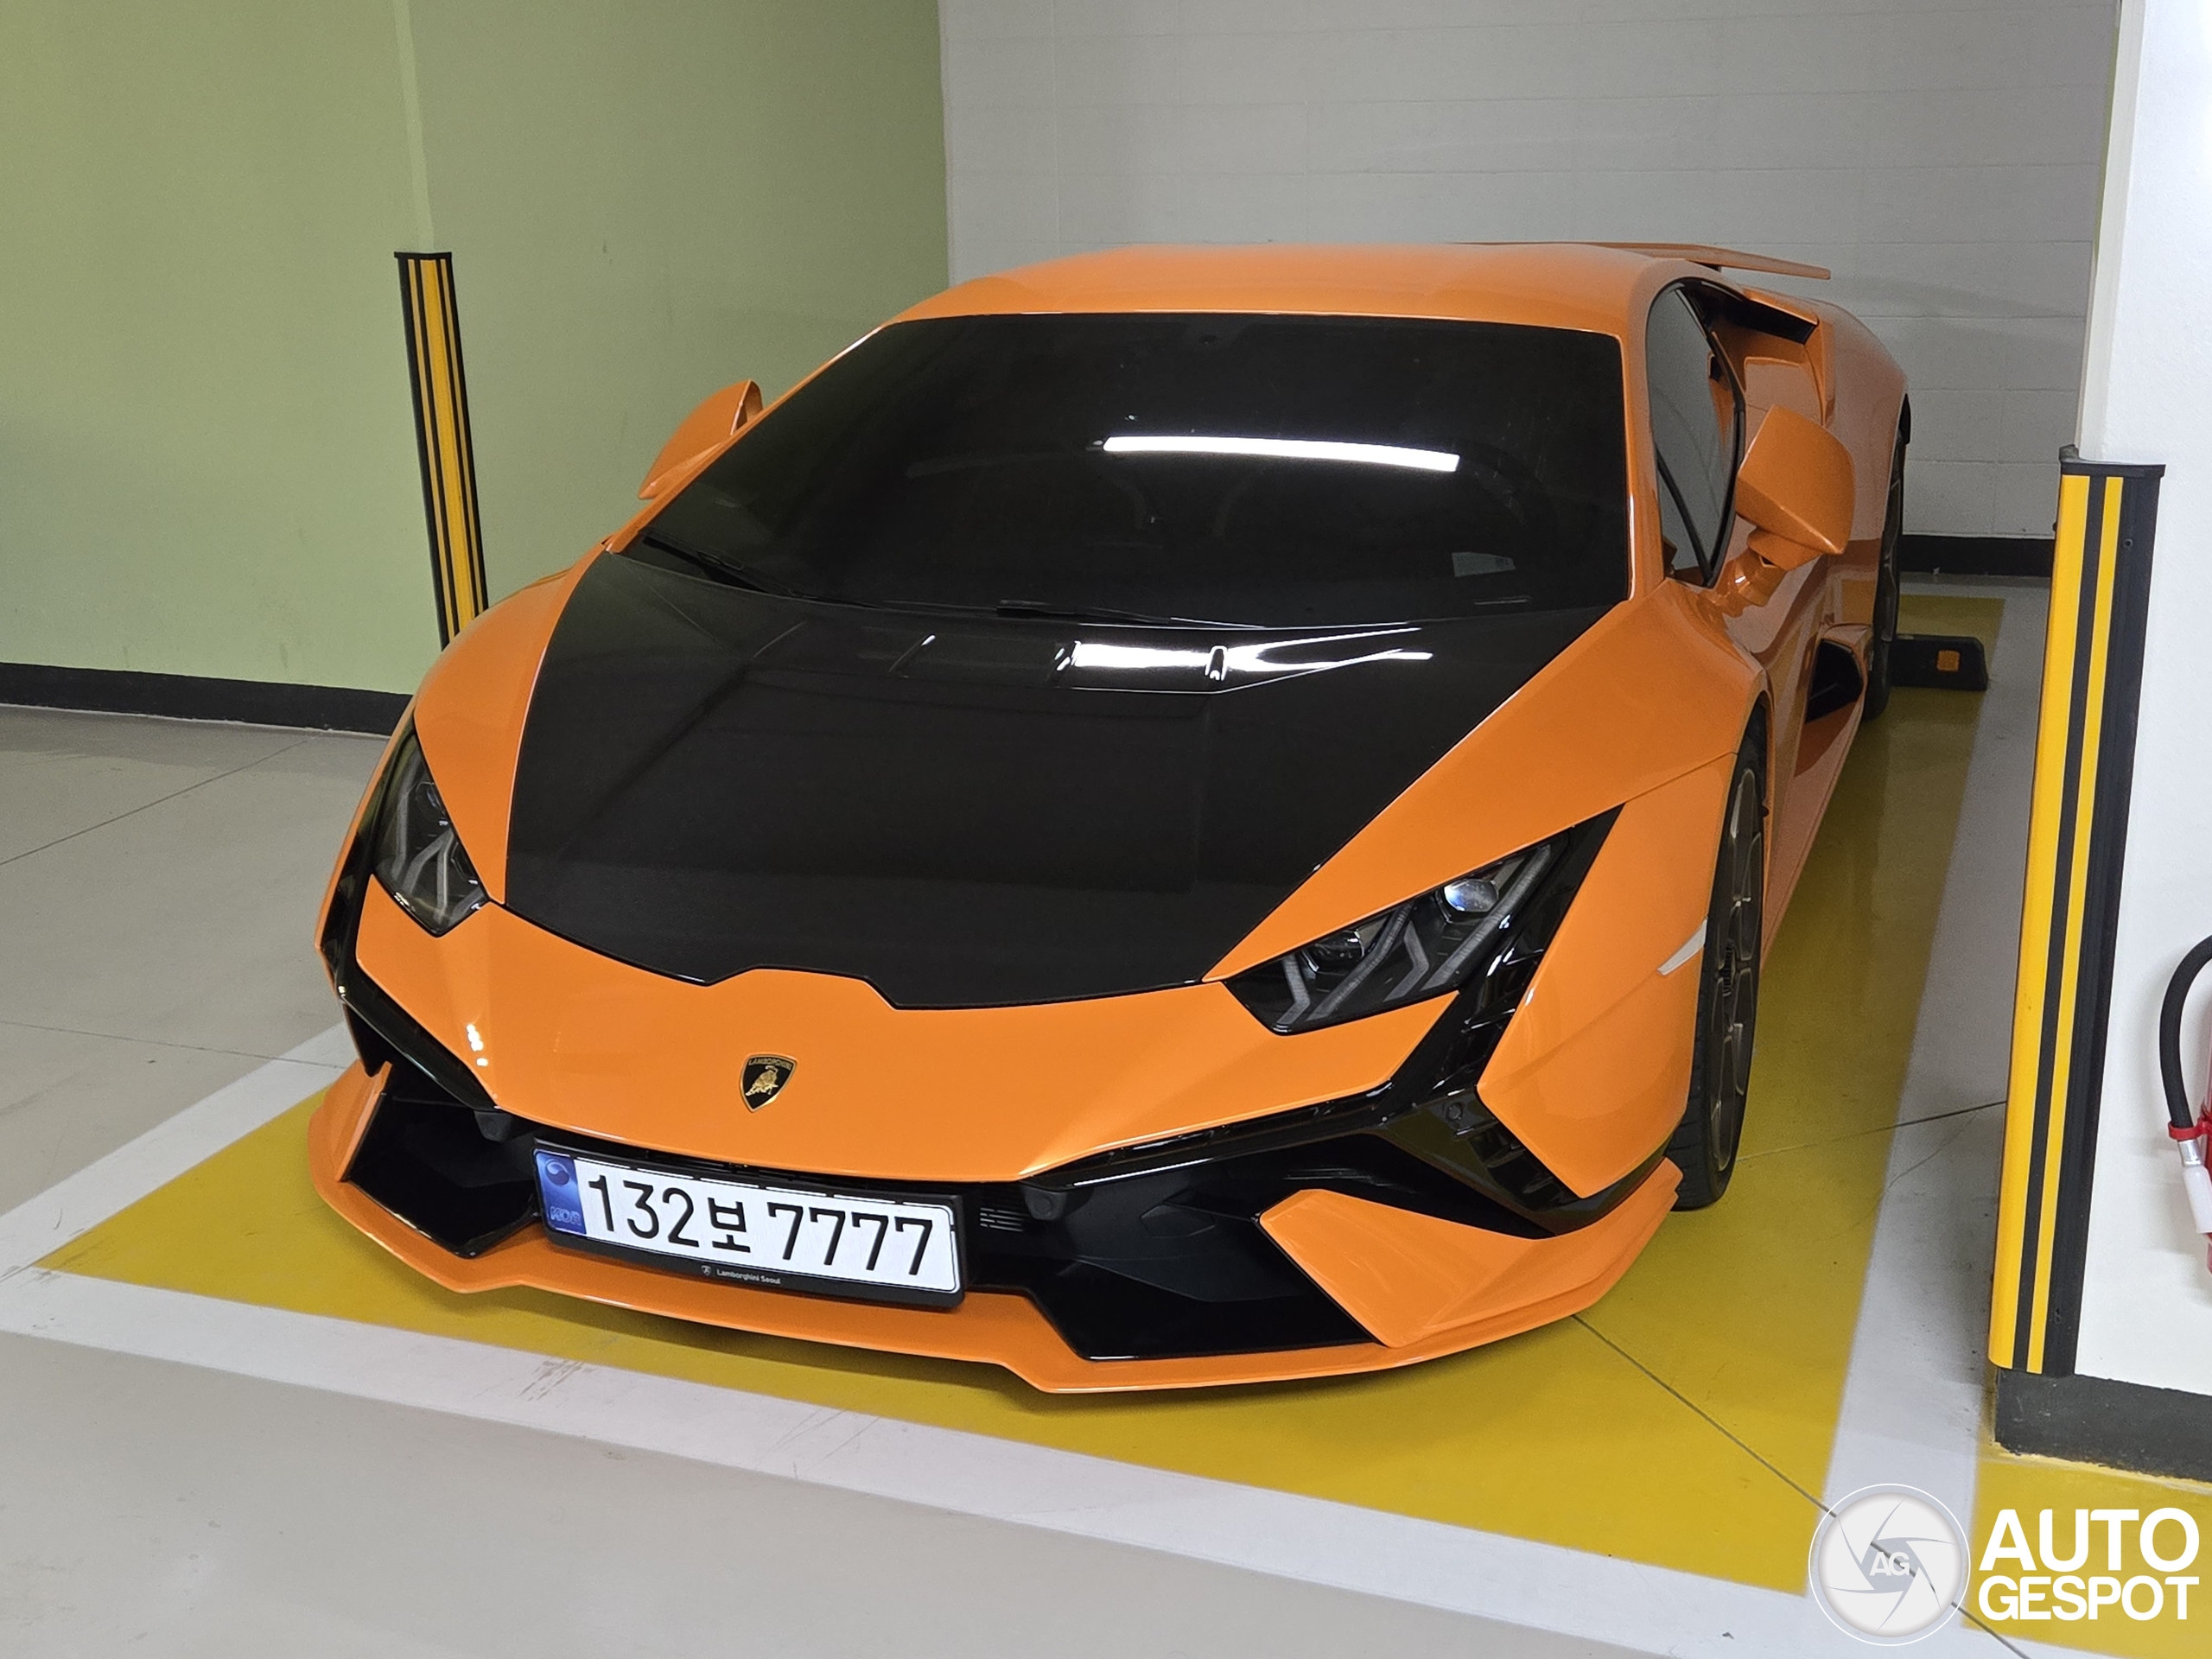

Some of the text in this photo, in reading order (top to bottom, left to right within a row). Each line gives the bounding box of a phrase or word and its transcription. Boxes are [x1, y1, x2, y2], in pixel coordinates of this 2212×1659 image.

[550, 1206, 582, 1225] KOR
[766, 1202, 932, 1275] 7777
[716, 1268, 780, 1284] Lamborghini Seoul
